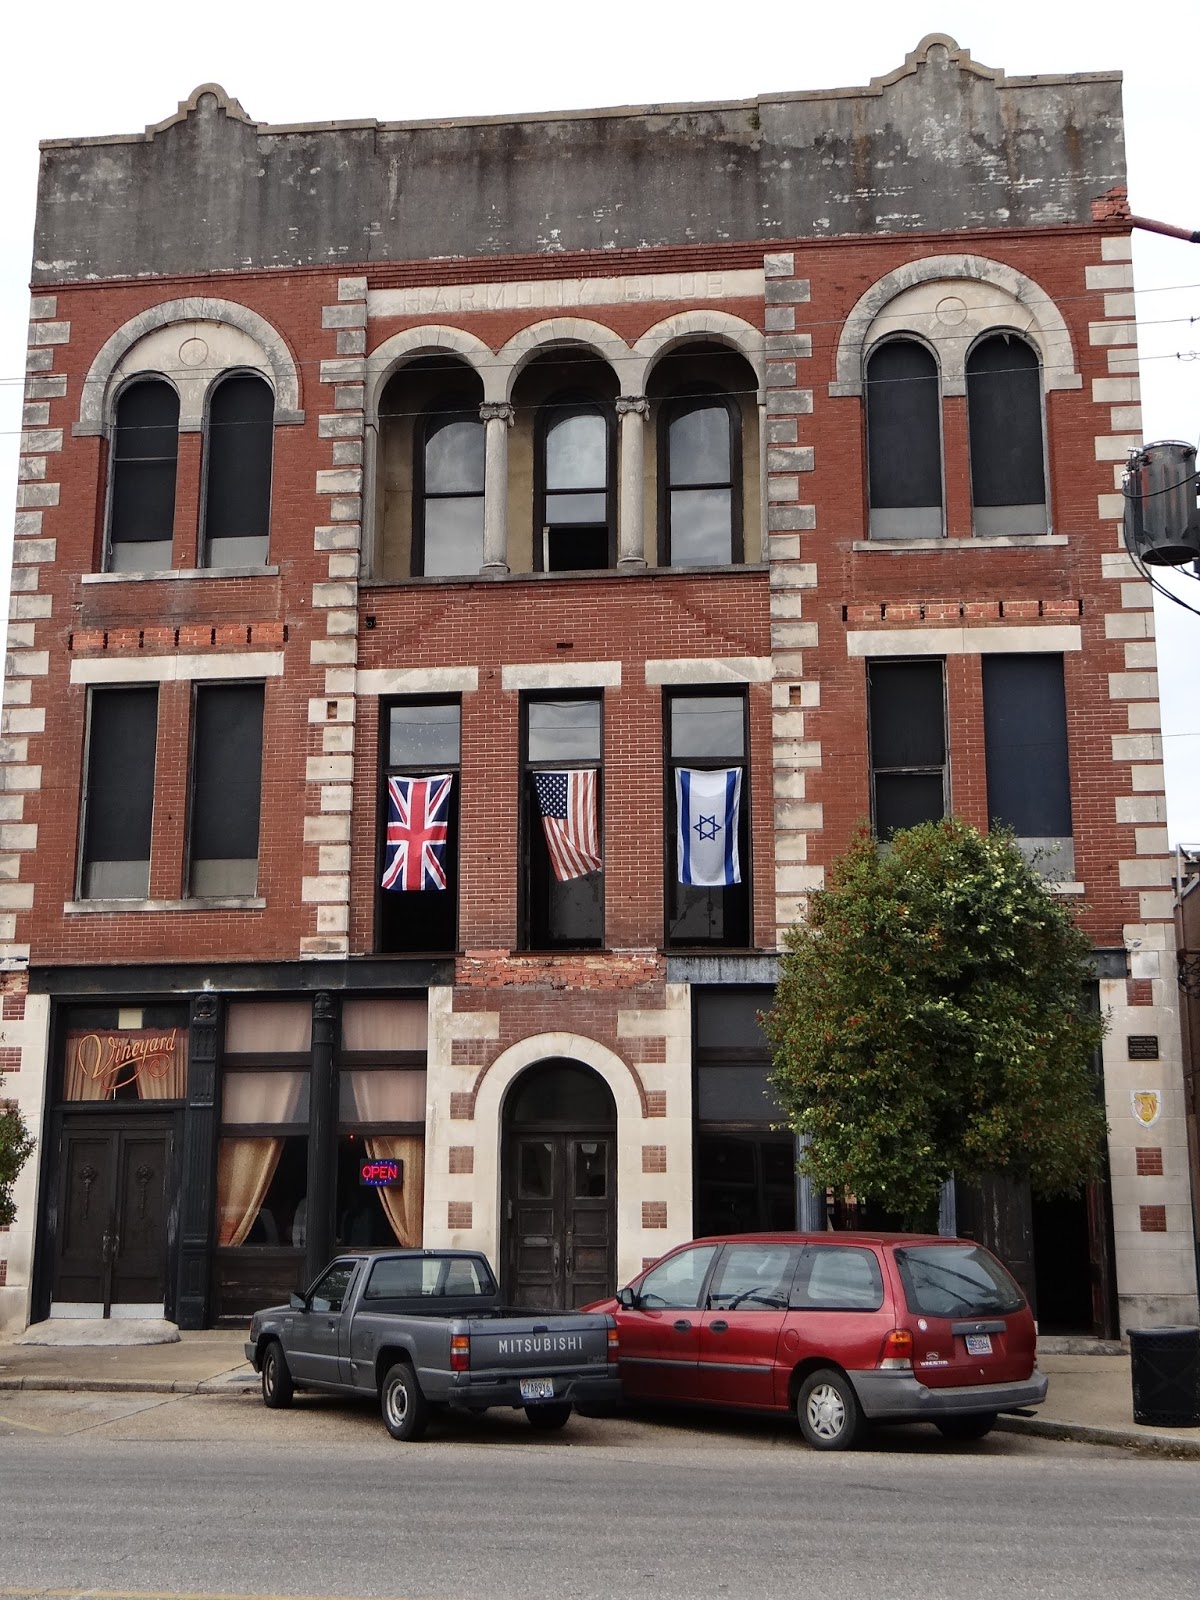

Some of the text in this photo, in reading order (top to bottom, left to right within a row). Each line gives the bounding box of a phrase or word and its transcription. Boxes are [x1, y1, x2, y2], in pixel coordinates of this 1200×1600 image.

[404, 273, 724, 311] HARMONY CLUB
[79, 1028, 177, 1089] Vineyard
[362, 1165, 398, 1179] OPEN
[499, 1336, 583, 1353] MITSUBISHI
